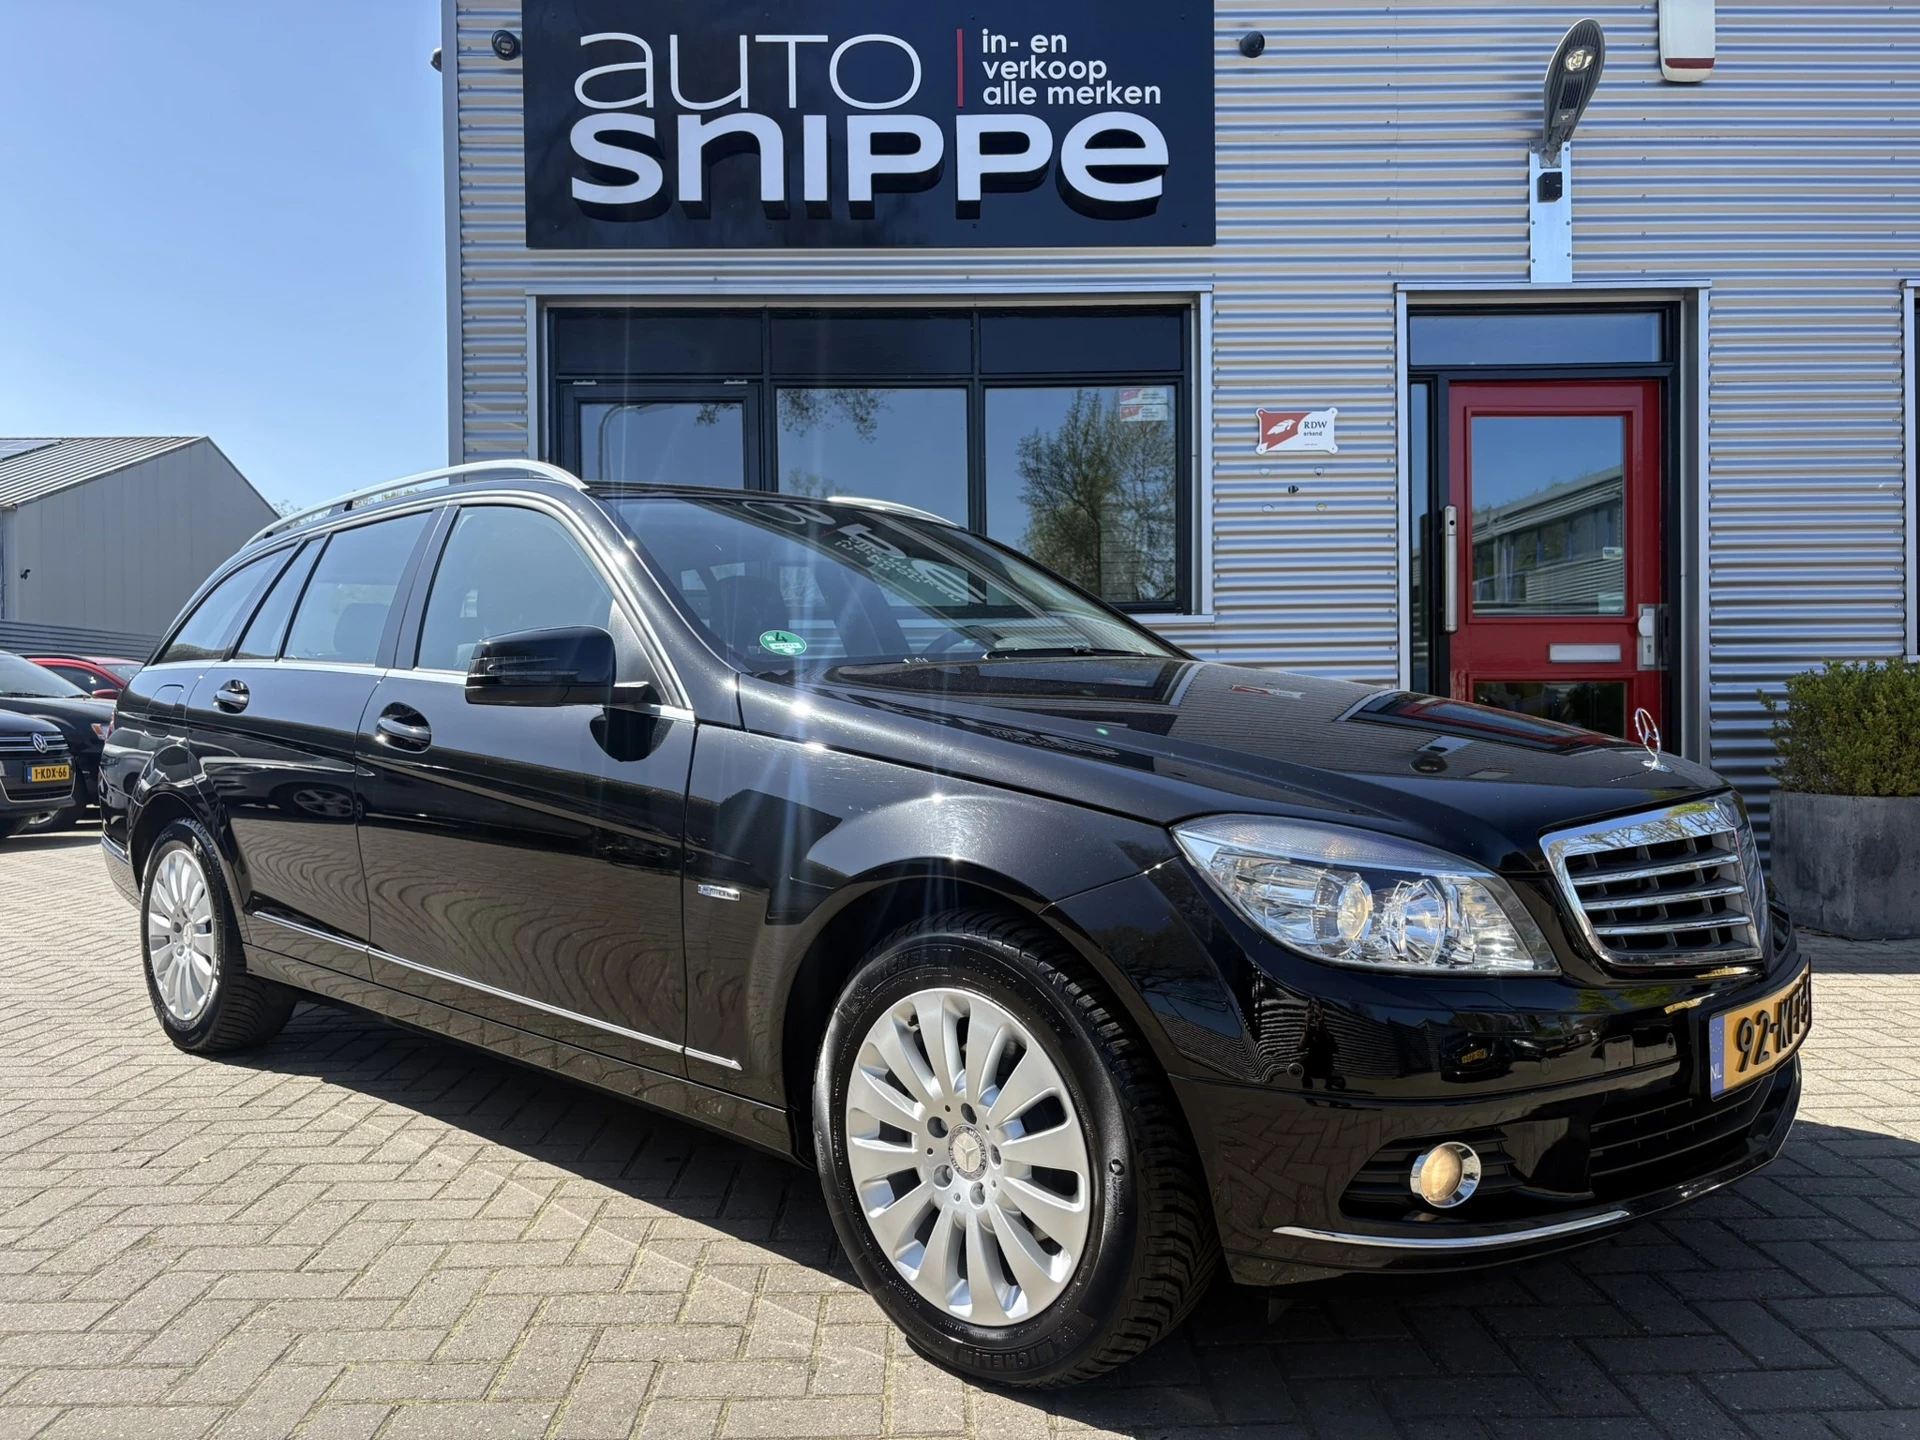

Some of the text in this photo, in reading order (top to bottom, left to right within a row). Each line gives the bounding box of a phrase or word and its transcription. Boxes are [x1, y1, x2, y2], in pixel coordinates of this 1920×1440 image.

[982, 28, 1067, 54] in- en
[982, 55, 1107, 84] verkoop
[982, 80, 1161, 105] alle merken
[1303, 421, 1328, 429] RDW
[775, 632, 789, 643] 4
[34, 766, 67, 780] 1-KDX-66
[1711, 1063, 1722, 1080] NL
